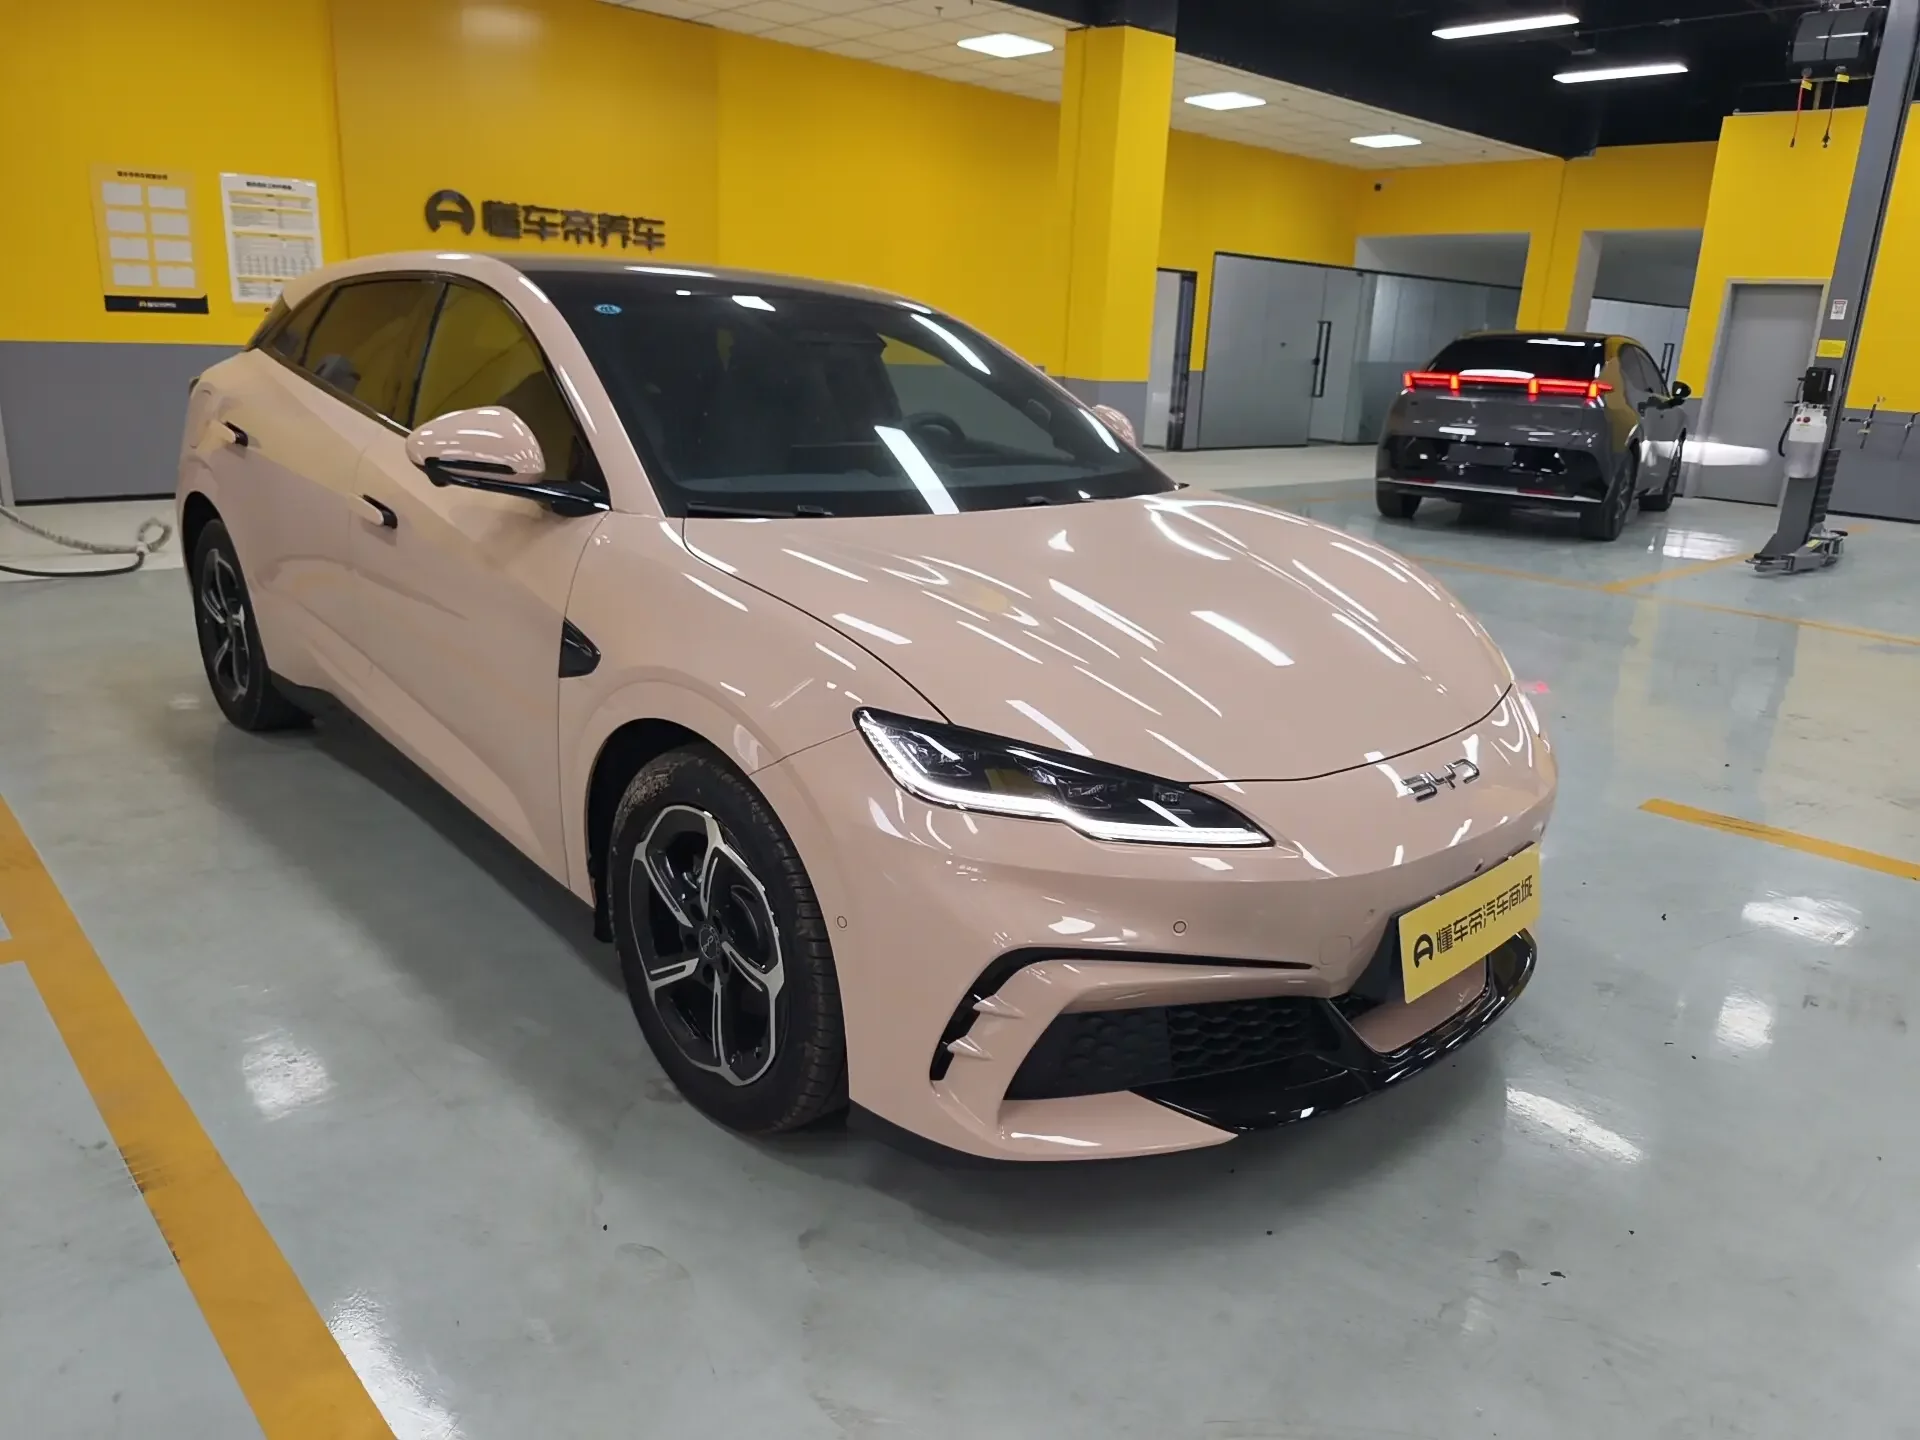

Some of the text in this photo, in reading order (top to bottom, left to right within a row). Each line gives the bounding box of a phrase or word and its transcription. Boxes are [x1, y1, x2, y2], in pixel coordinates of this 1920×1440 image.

[1401, 758, 1480, 802] BYD
[1436, 874, 1533, 954] 懂车帝汽车商城
